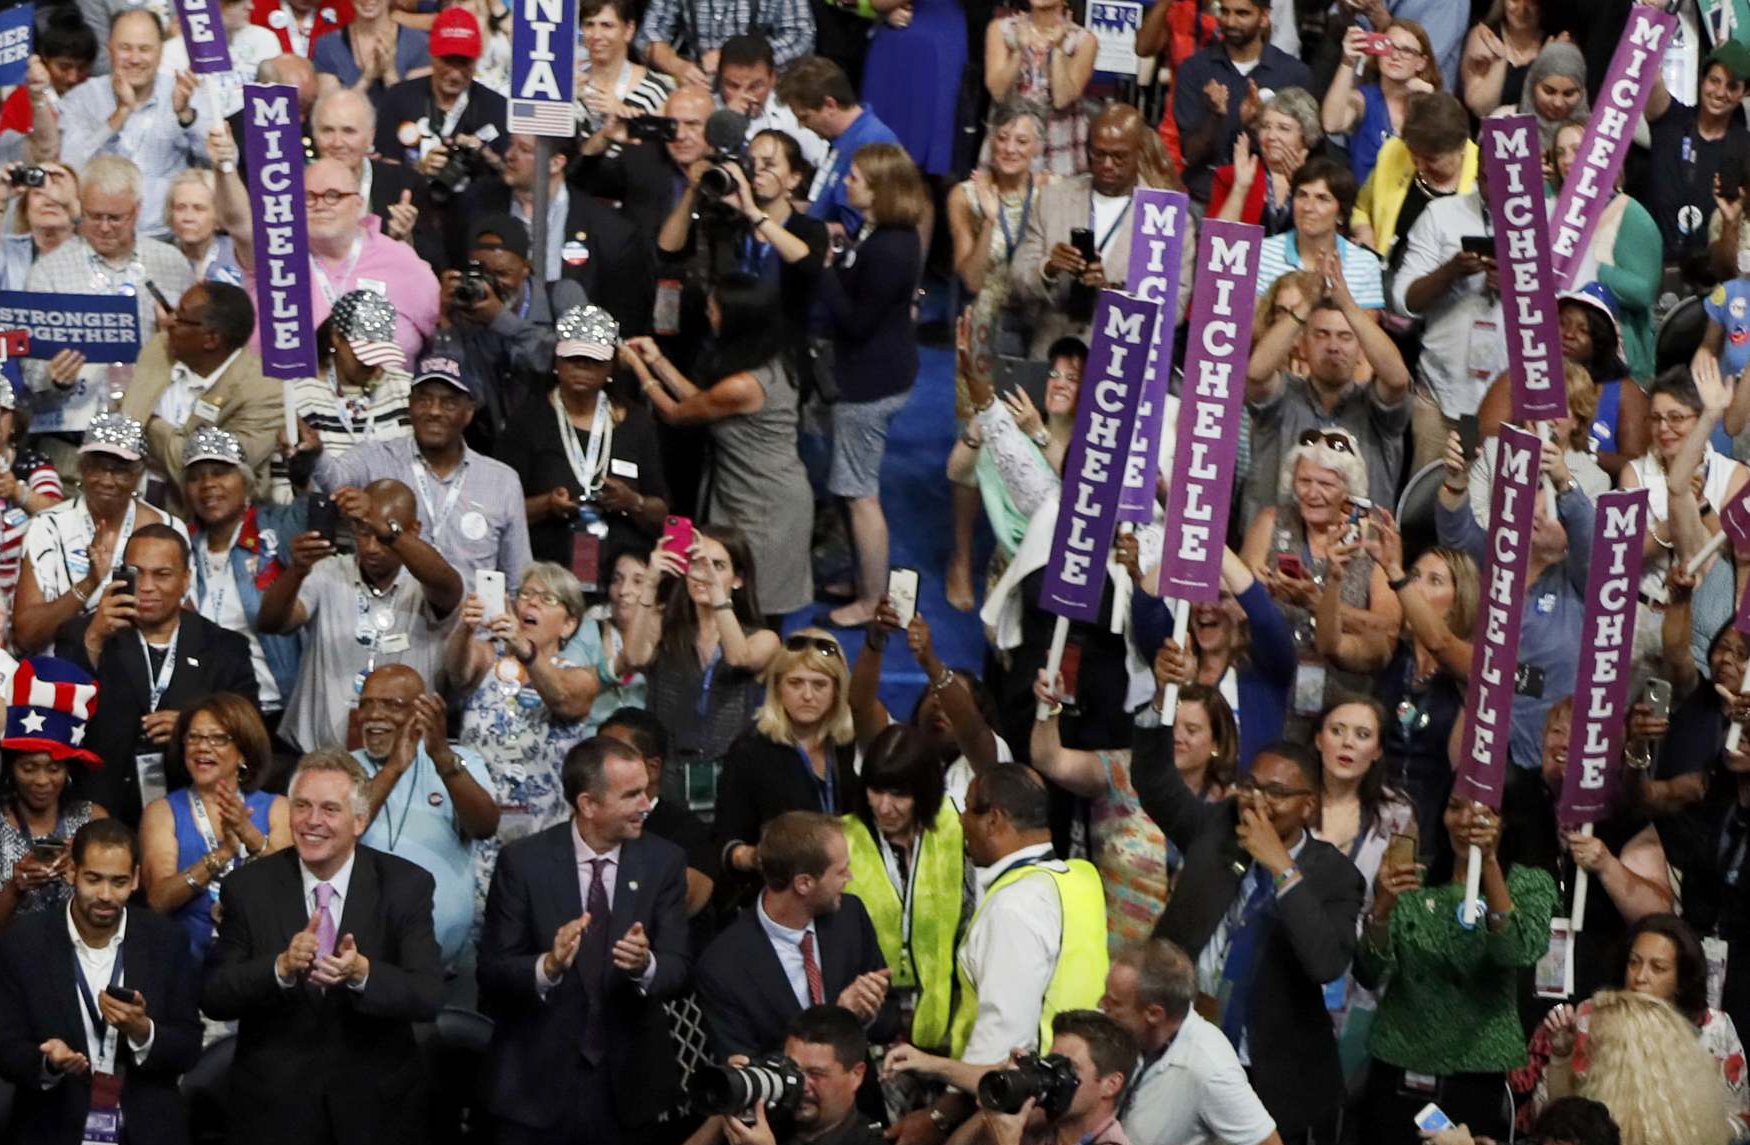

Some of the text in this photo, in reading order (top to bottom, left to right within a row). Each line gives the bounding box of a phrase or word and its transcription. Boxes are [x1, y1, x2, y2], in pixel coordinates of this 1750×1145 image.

[253, 97, 300, 350] MICHELLE
[1493, 127, 1550, 391] MICHELLE
[1552, 16, 1665, 259] MICHELLE
[1059, 304, 1145, 586] MICHELLE
[1177, 235, 1250, 562] MICHELLE
[1472, 441, 1531, 765] MICHELLE
[1579, 503, 1640, 790] MICHELLE
